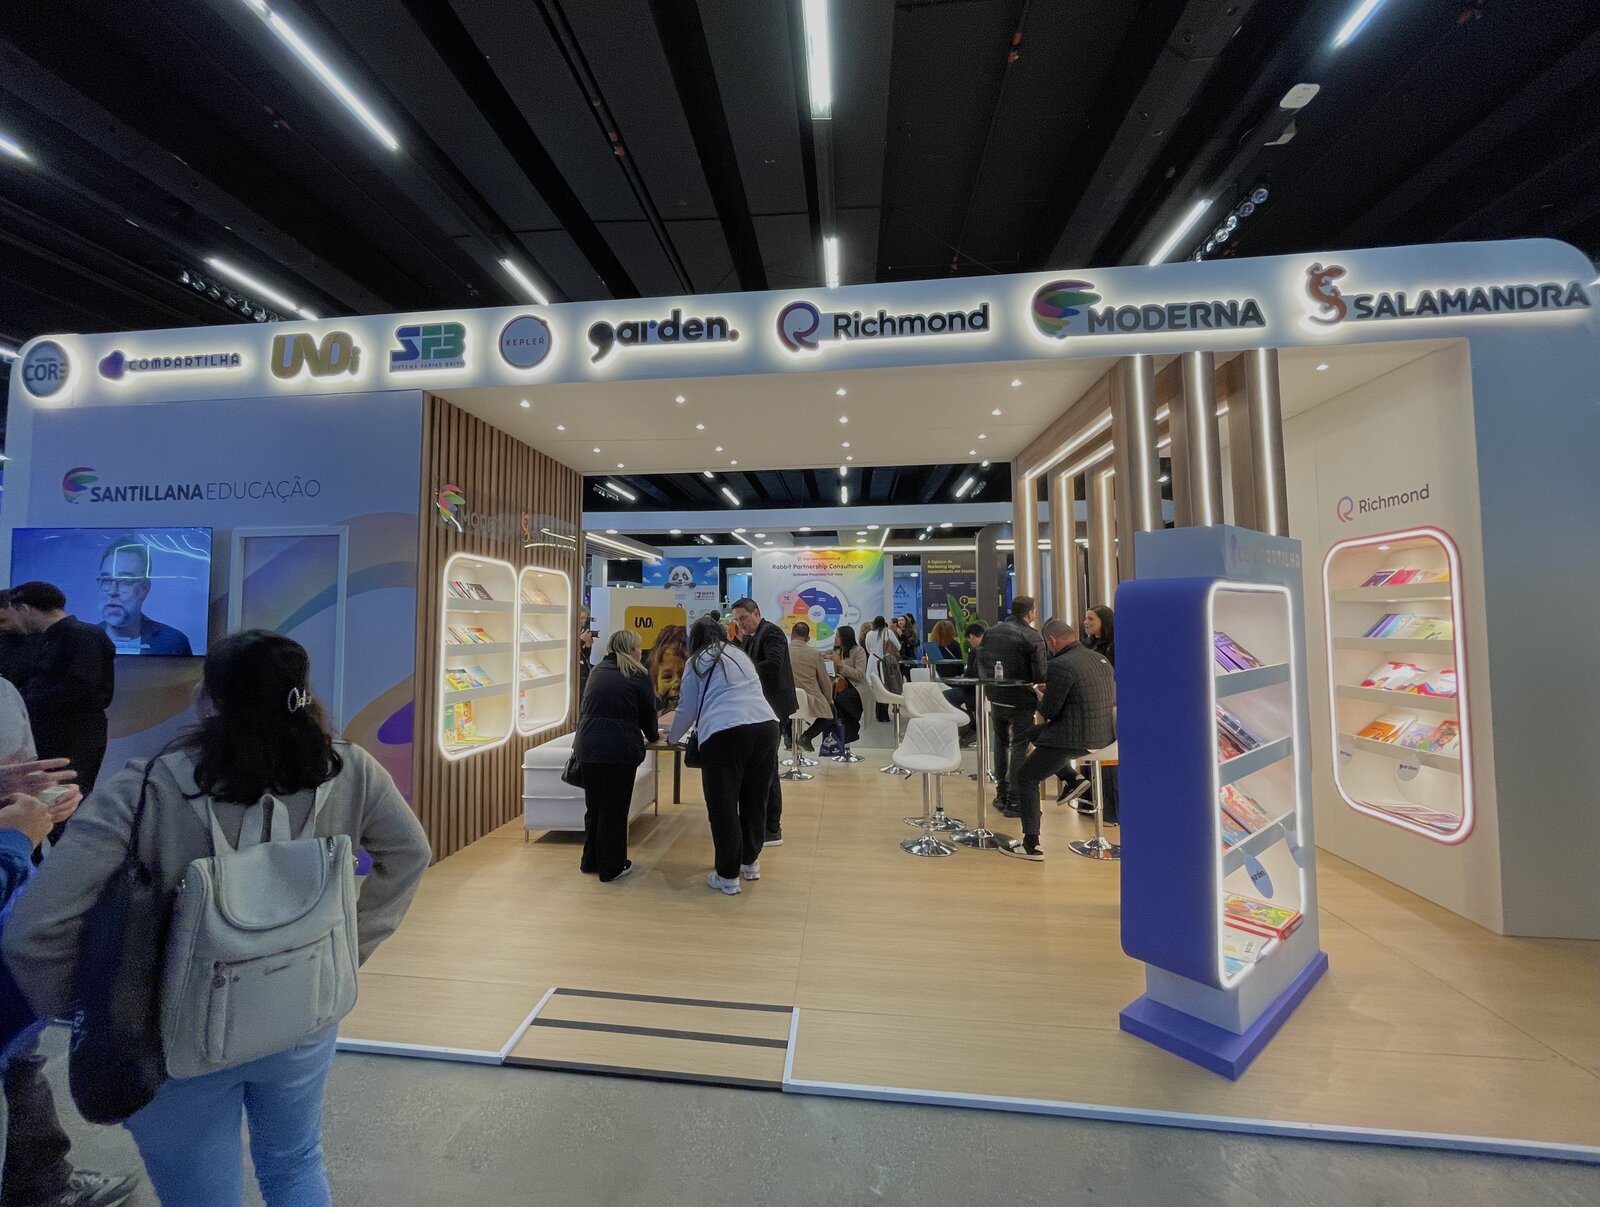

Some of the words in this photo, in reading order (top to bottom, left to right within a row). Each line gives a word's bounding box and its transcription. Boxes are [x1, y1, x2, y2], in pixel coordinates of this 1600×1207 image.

[1353, 281, 1591, 318] SALAMANDRA
[833, 302, 990, 340] Richmond
[1087, 299, 1265, 333] MODERNA
[505, 338, 545, 346] KEPLER
[24, 362, 67, 382] CORE
[128, 352, 241, 371] COMPARTILHA
[89, 483, 204, 502] SANTILLANA
[1358, 484, 1430, 514] Richmond
